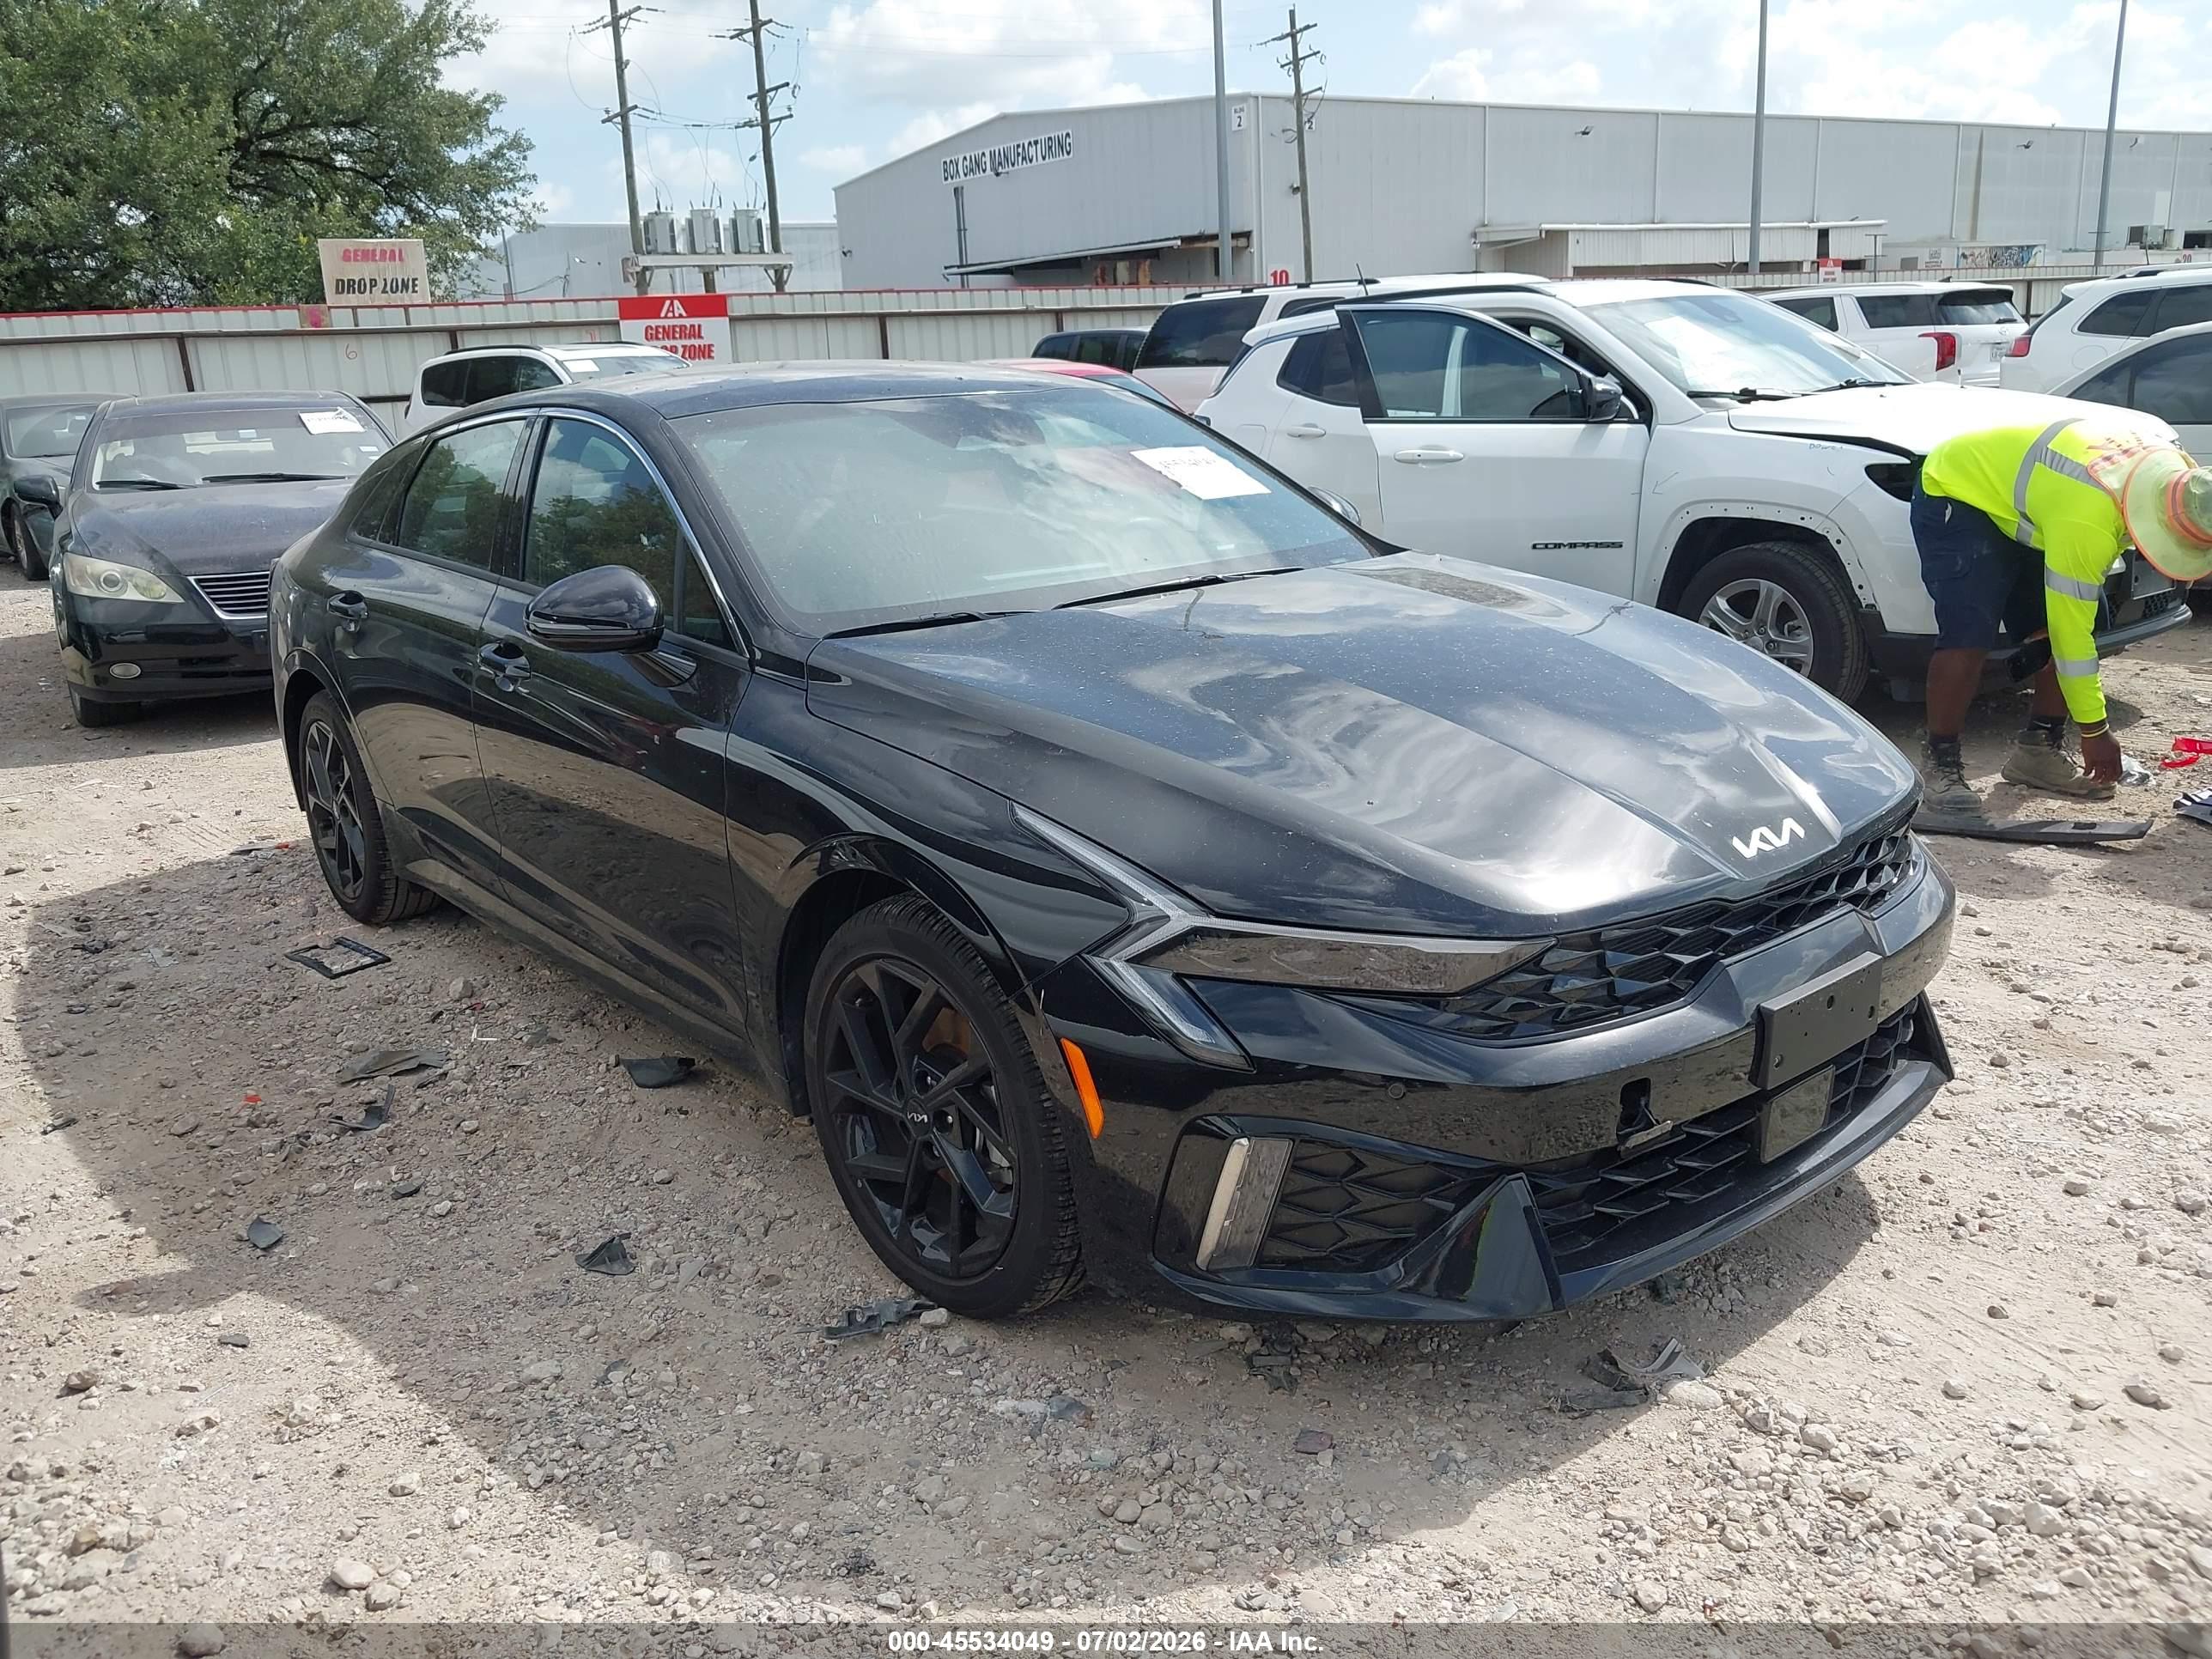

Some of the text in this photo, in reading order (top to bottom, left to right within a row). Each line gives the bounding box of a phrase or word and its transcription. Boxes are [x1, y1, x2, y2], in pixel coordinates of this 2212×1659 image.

[1237, 115, 1243, 128] 2
[943, 131, 1072, 182] BOX GANG MANUFACTURING
[343, 248, 404, 263] GENERAL
[335, 277, 418, 295] DROP ZONE
[1271, 270, 1290, 285] 10
[644, 324, 704, 342] GENERAL
[345, 343, 358, 361] 6
[680, 343, 715, 361] ZONE
[1532, 541, 1623, 550] COMPASS
[1732, 817, 1805, 859] KIA
